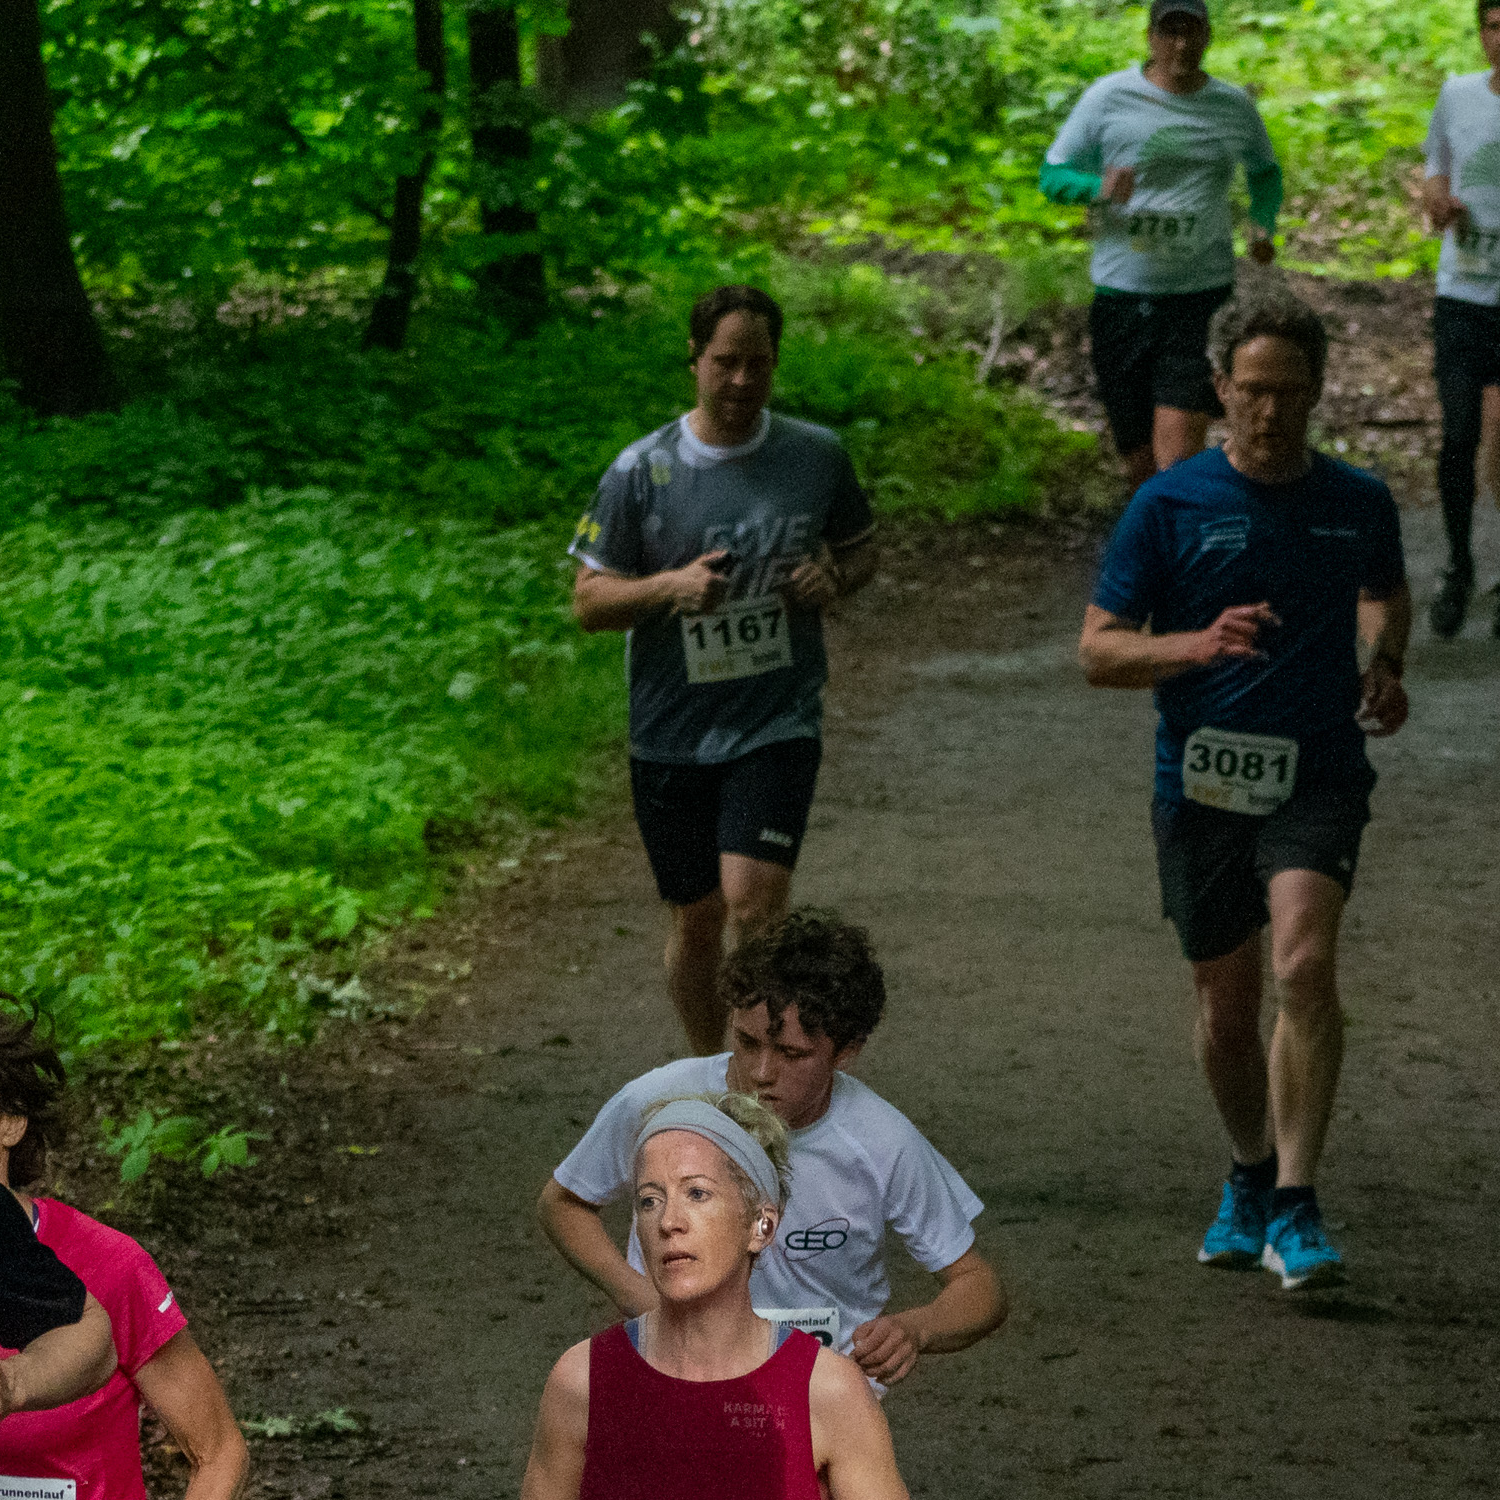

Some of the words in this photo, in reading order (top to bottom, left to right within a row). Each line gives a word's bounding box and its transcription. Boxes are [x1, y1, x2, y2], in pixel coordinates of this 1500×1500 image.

[688, 607, 783, 650] 1167
[1188, 743, 1288, 783] 3081
[785, 1230, 848, 1250] GEO
